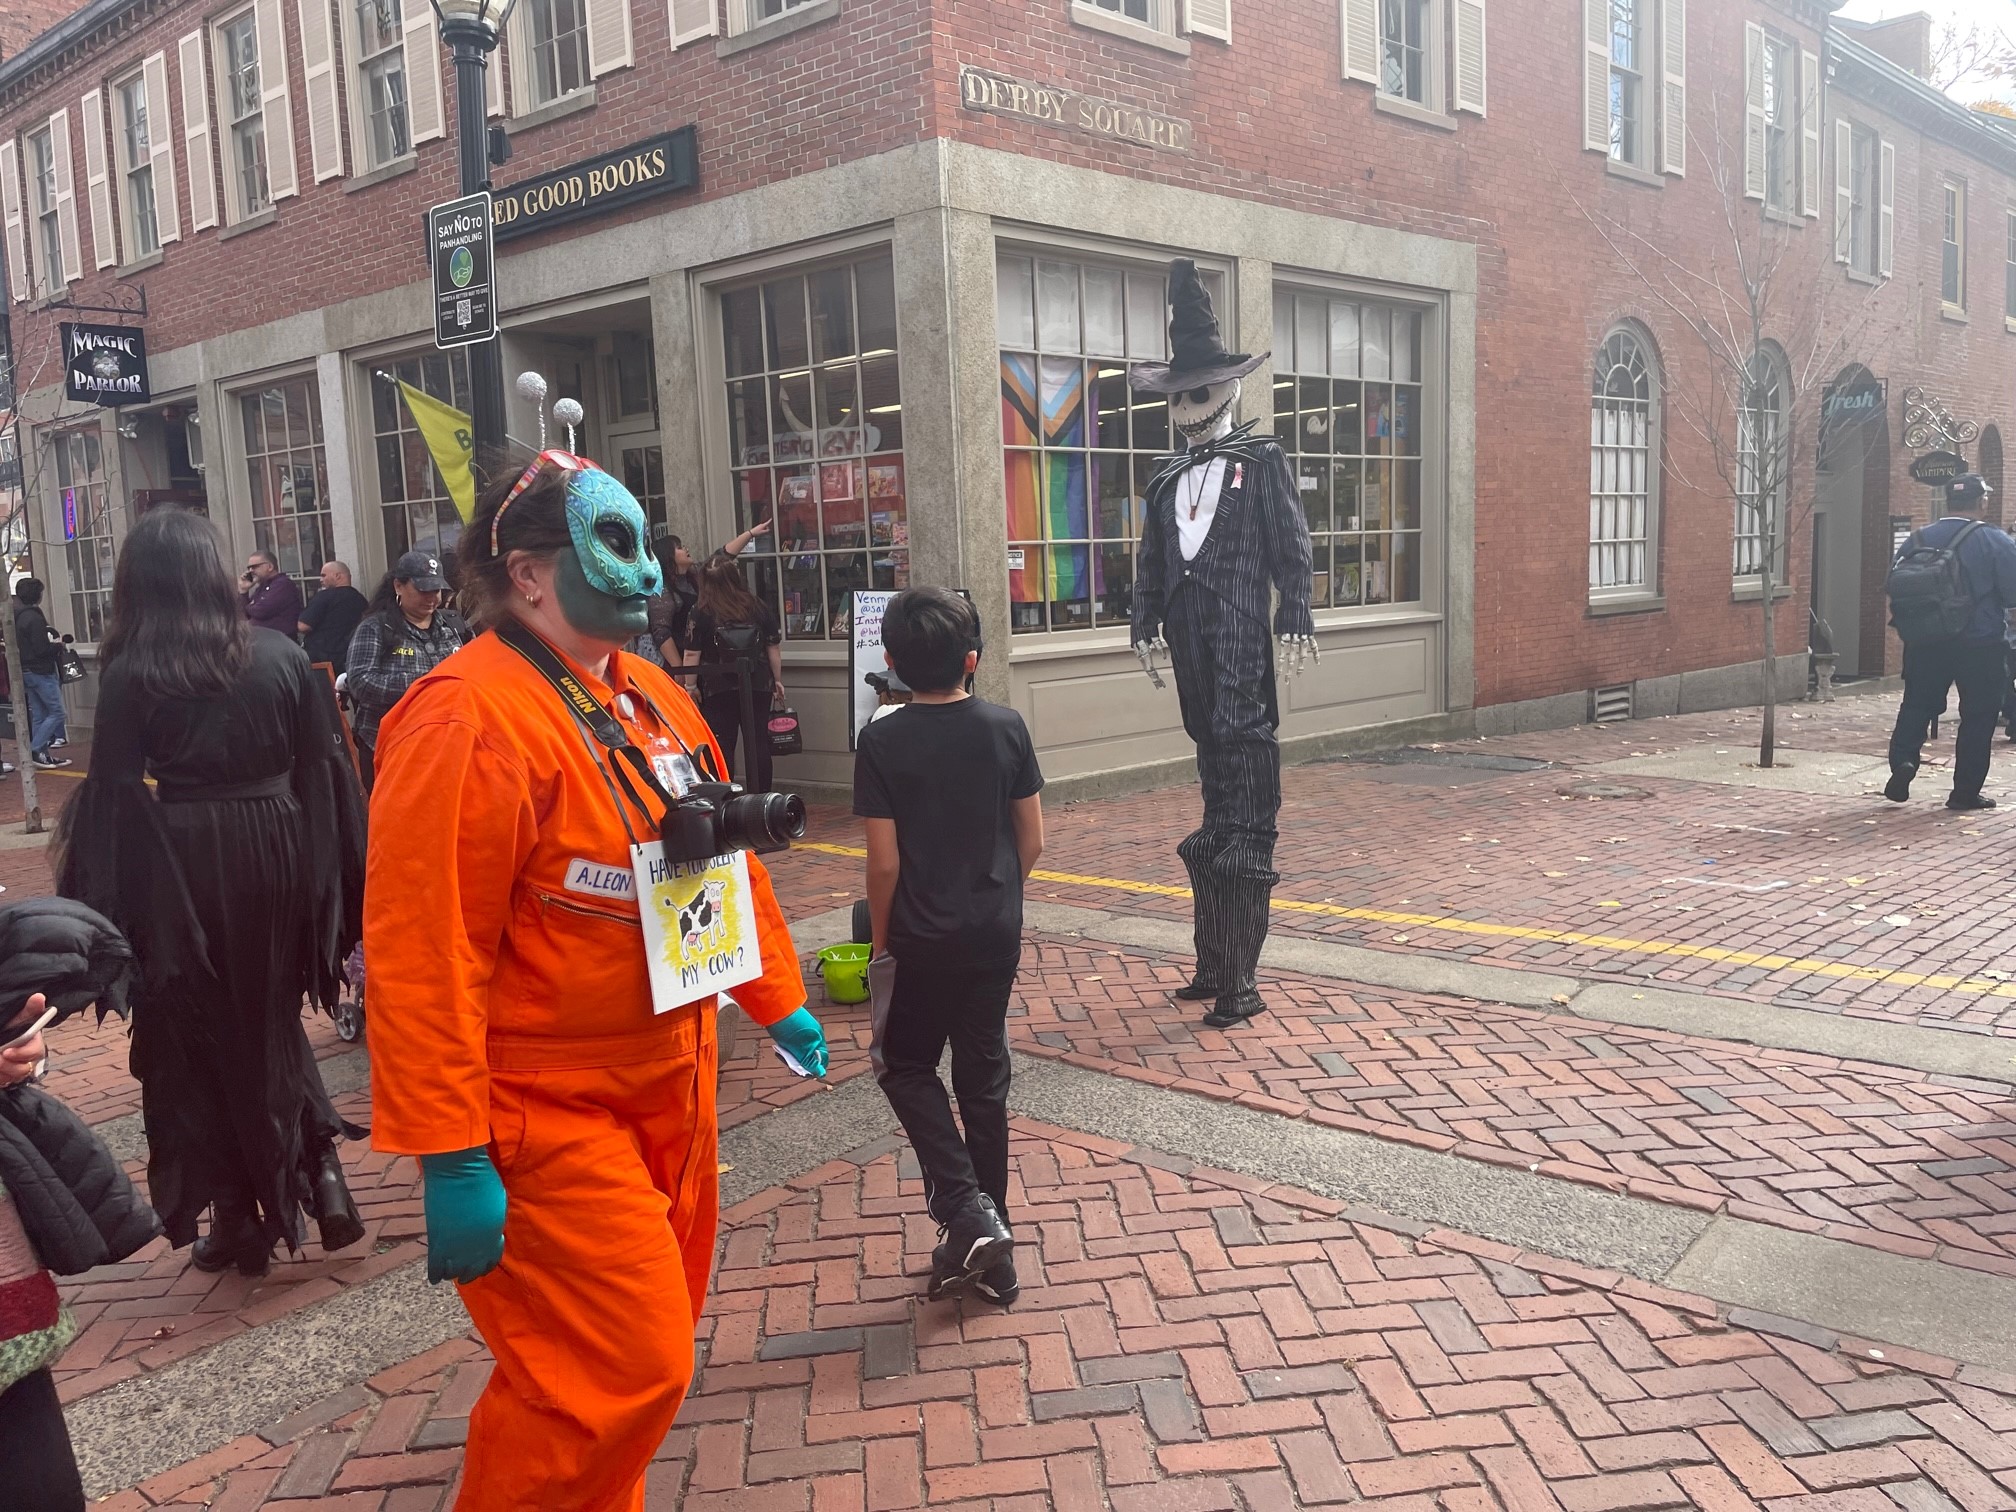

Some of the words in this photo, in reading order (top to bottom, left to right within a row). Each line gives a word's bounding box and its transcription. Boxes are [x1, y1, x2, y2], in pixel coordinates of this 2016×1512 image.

[964, 73, 1069, 123] DERBY
[1079, 100, 1184, 150] SQUARE
[523, 176, 584, 216] GOOD
[587, 148, 666, 198] BOOKS
[438, 223, 454, 238] SAY
[454, 216, 471, 234] NO
[470, 216, 483, 229] TO
[440, 231, 483, 250] PANHANDLING
[73, 331, 137, 358] MAGIC
[73, 369, 143, 393] PARLOR
[1824, 390, 1874, 417] fresh
[560, 676, 597, 714] Nikon
[575, 866, 634, 893] A.LEON
[649, 857, 682, 885] HAVE
[681, 963, 700, 989] MY
